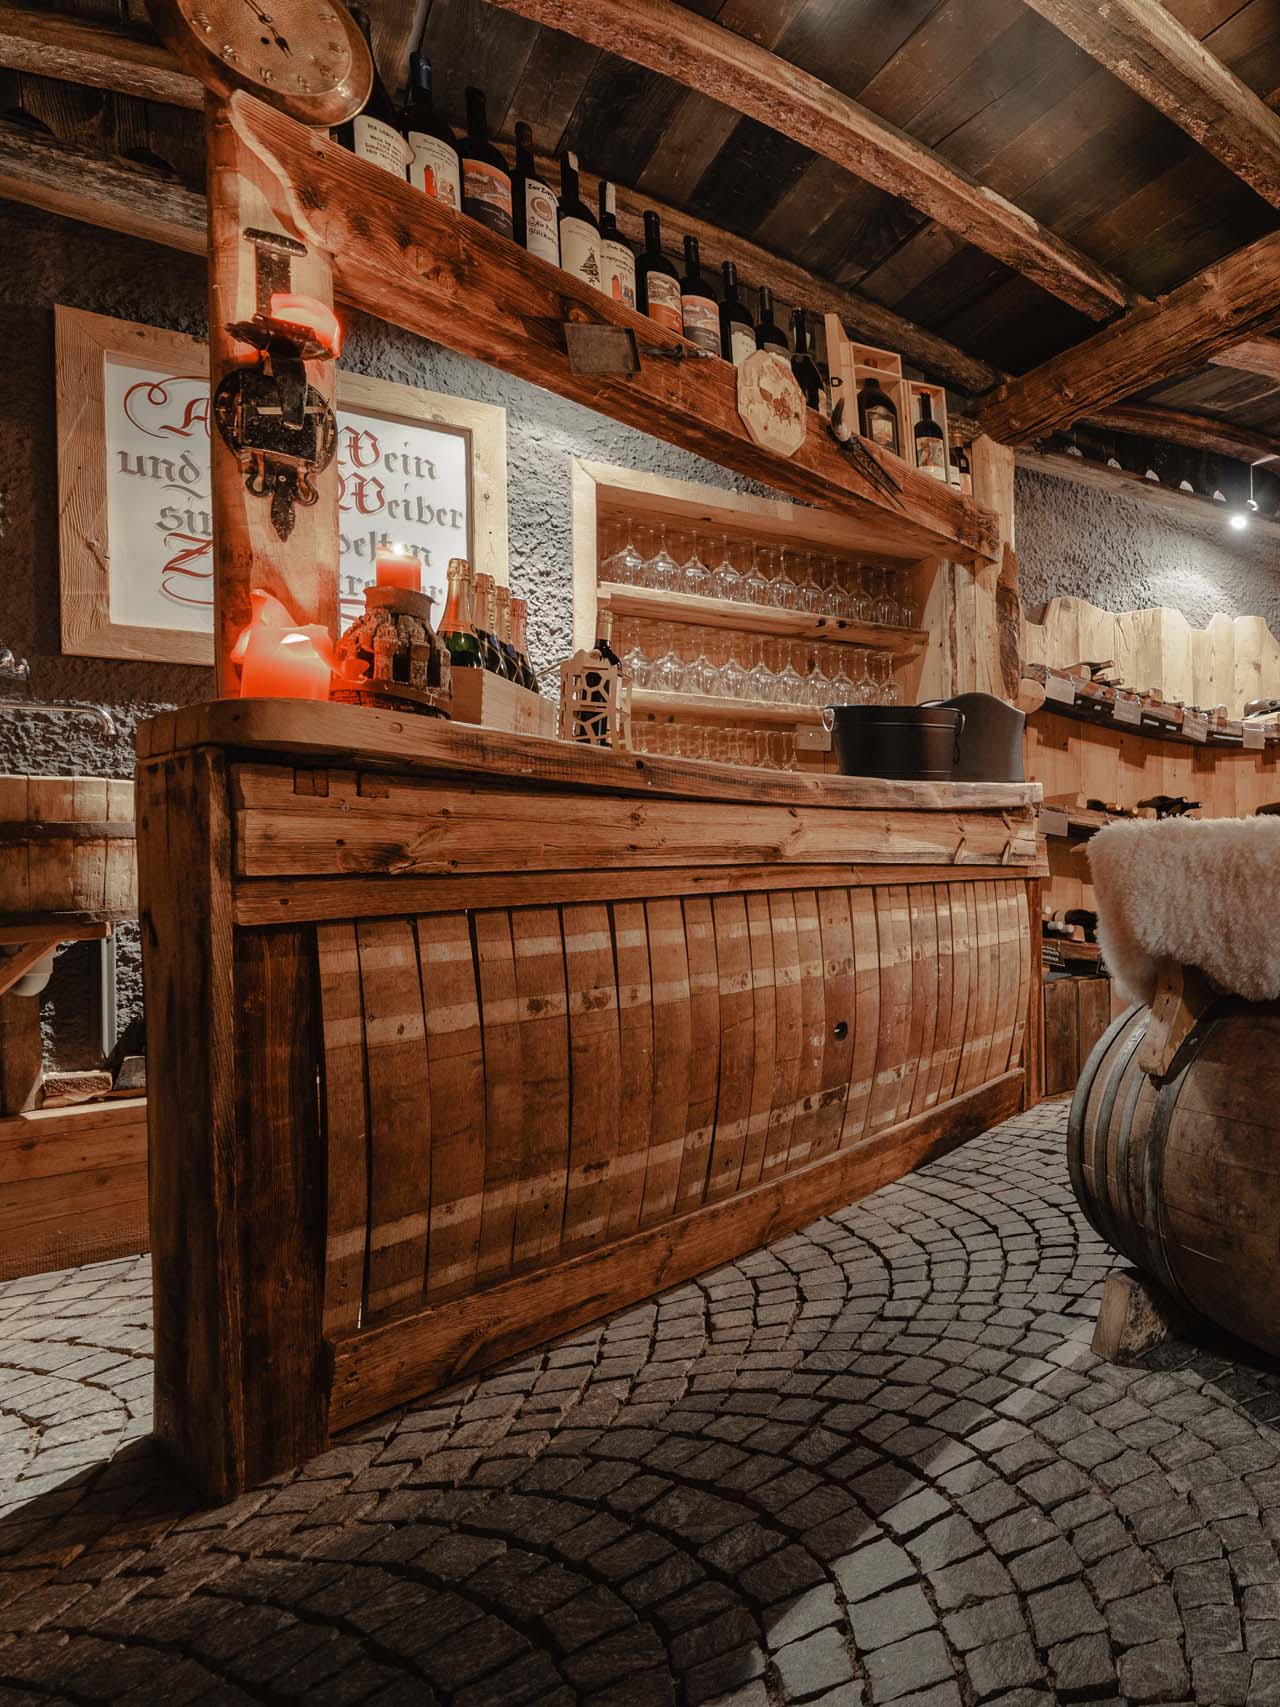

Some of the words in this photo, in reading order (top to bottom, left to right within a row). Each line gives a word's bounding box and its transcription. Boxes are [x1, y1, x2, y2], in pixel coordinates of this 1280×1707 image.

[338, 425, 437, 480] Wein
[117, 450, 200, 484] und
[338, 472, 464, 529] Weiber
